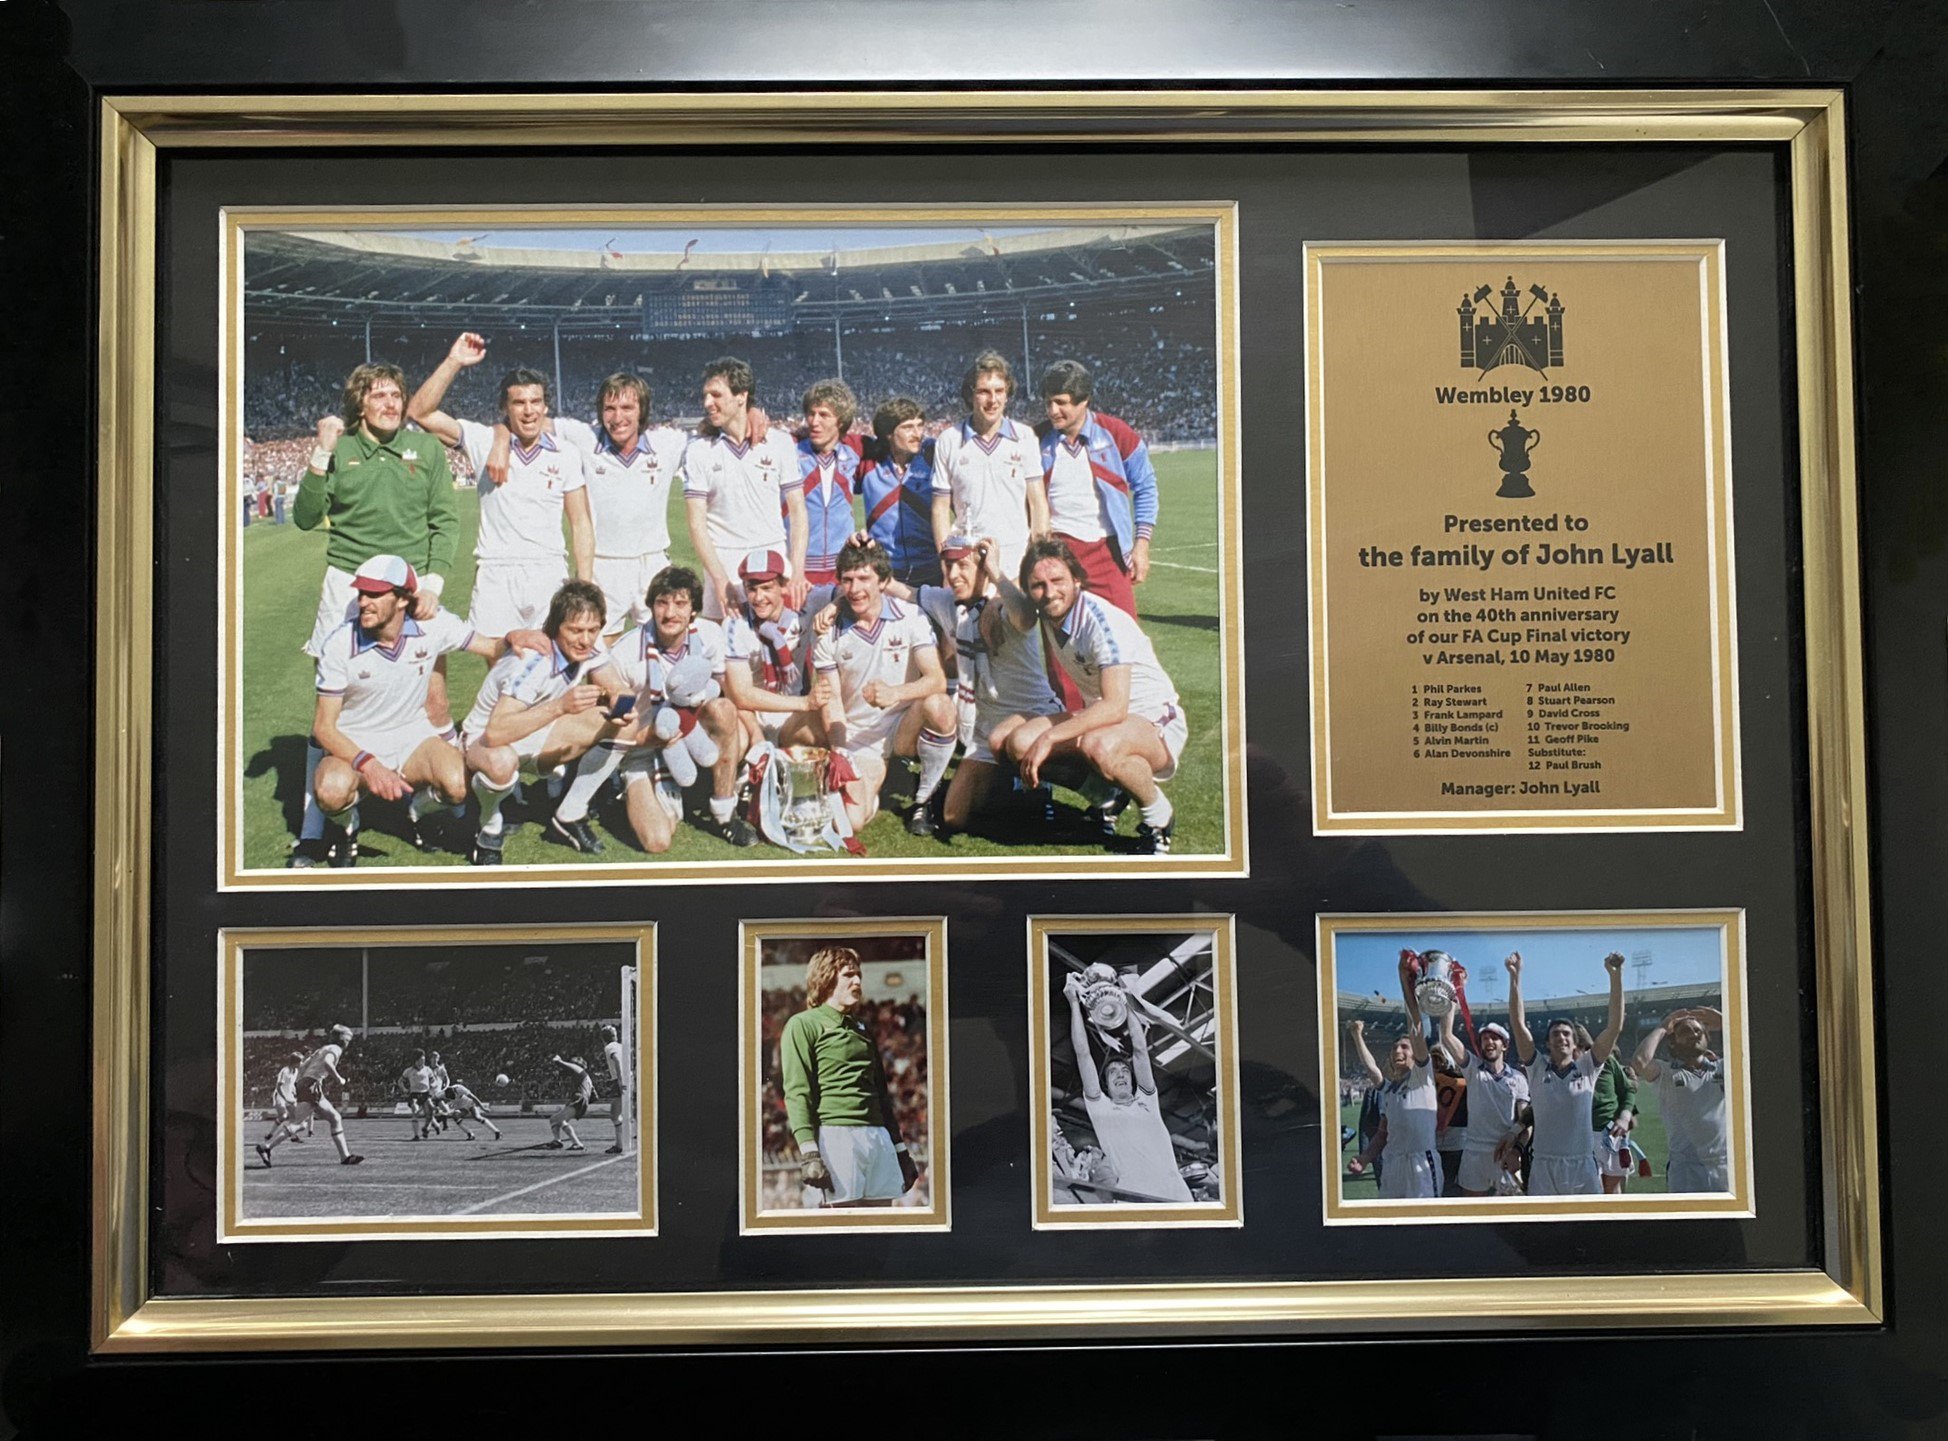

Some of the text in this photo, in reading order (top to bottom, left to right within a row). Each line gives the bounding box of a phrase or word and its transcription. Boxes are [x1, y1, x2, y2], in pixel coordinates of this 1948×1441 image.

[1435, 385, 1591, 407] Wembley 1980
[1444, 512, 1589, 533] Presented to
[1358, 542, 1674, 572] the family of John Lyall
[1419, 585, 1617, 605] by West Ham United FC
[1416, 607, 1620, 625] on the 40th anniversary
[1406, 627, 1631, 647] of our FA Cup Final victory
[1422, 648, 1616, 667] v Arsenal, 10 May 1980
[1411, 684, 1482, 695] 1 Phil Parkes
[1525, 682, 1591, 693] 7 Paul Allen
[1411, 697, 1488, 709] 2 Ray Stewart
[1526, 695, 1616, 706] 8 Stuart Pearson
[1412, 709, 1504, 721] 3 Frank Lampard
[1526, 708, 1601, 719] 9 David Cross
[1412, 722, 1499, 735] 4 Billy Bonds (c)
[1527, 720, 1630, 733] 10 Trevor Brooking
[1412, 735, 1490, 746] 5 Alvin Martin
[1527, 734, 1600, 745] 11 Geoff Pike
[1413, 748, 1512, 759] 6 Alan Devonshire
[1527, 747, 1587, 758] Substitute:
[1528, 760, 1602, 771] 12 Paul Brush
[1441, 780, 1601, 799] Manager: John Lyall
